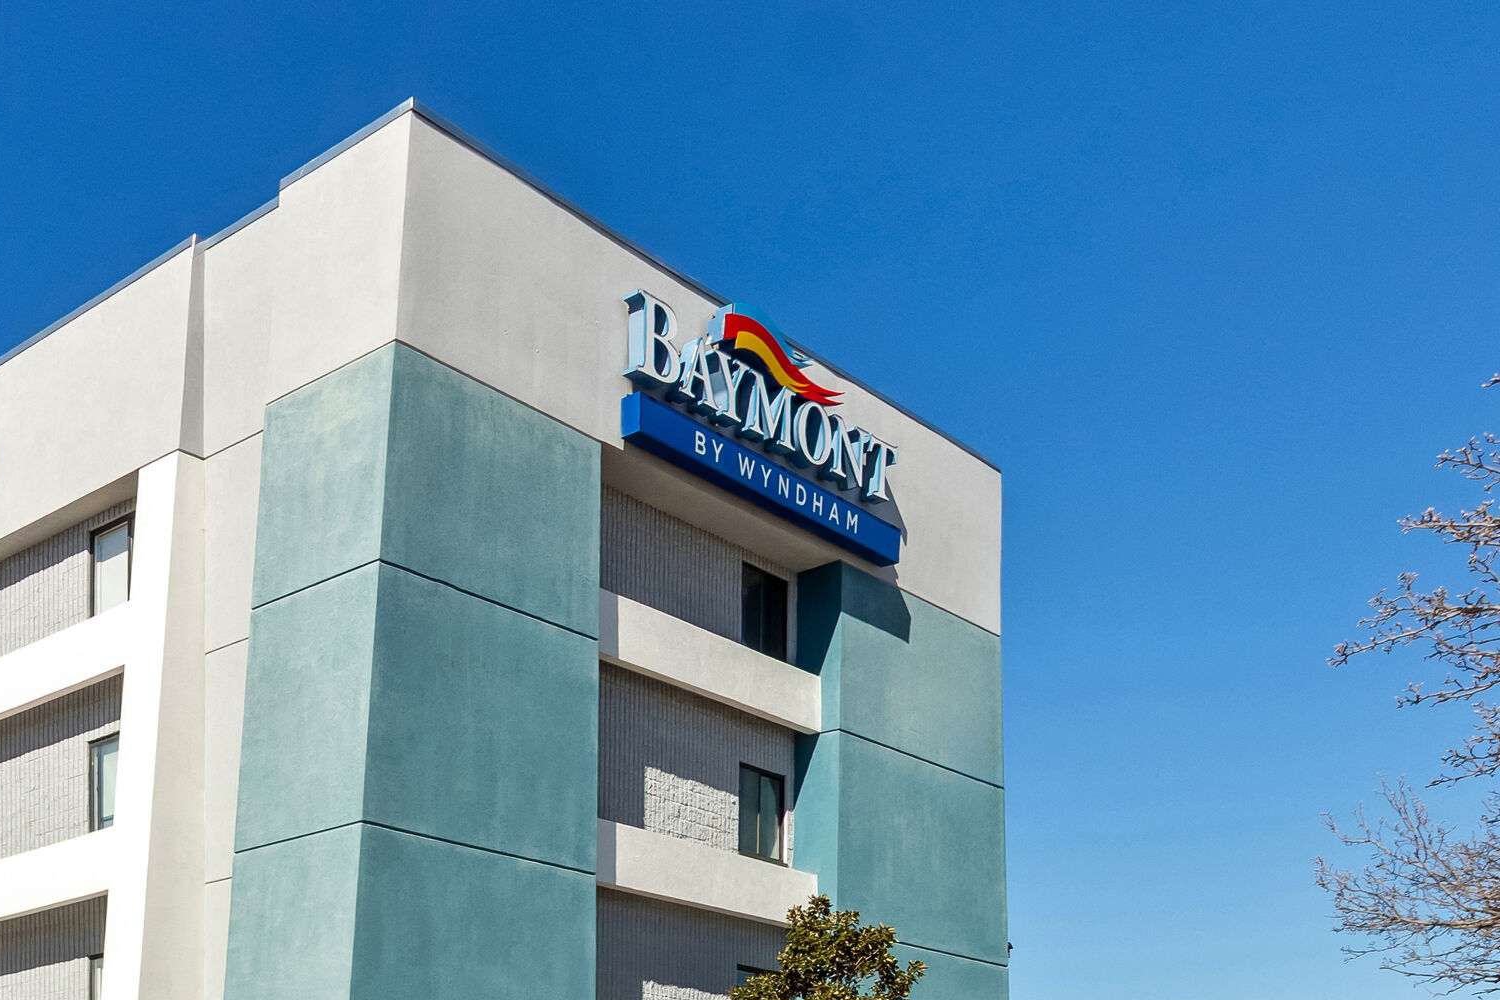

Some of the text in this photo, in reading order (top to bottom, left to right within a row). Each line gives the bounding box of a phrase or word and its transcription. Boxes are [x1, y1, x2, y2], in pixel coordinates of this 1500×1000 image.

[623, 288, 899, 502] BAYMONT
[694, 430, 859, 535] BY WYNDHAM
